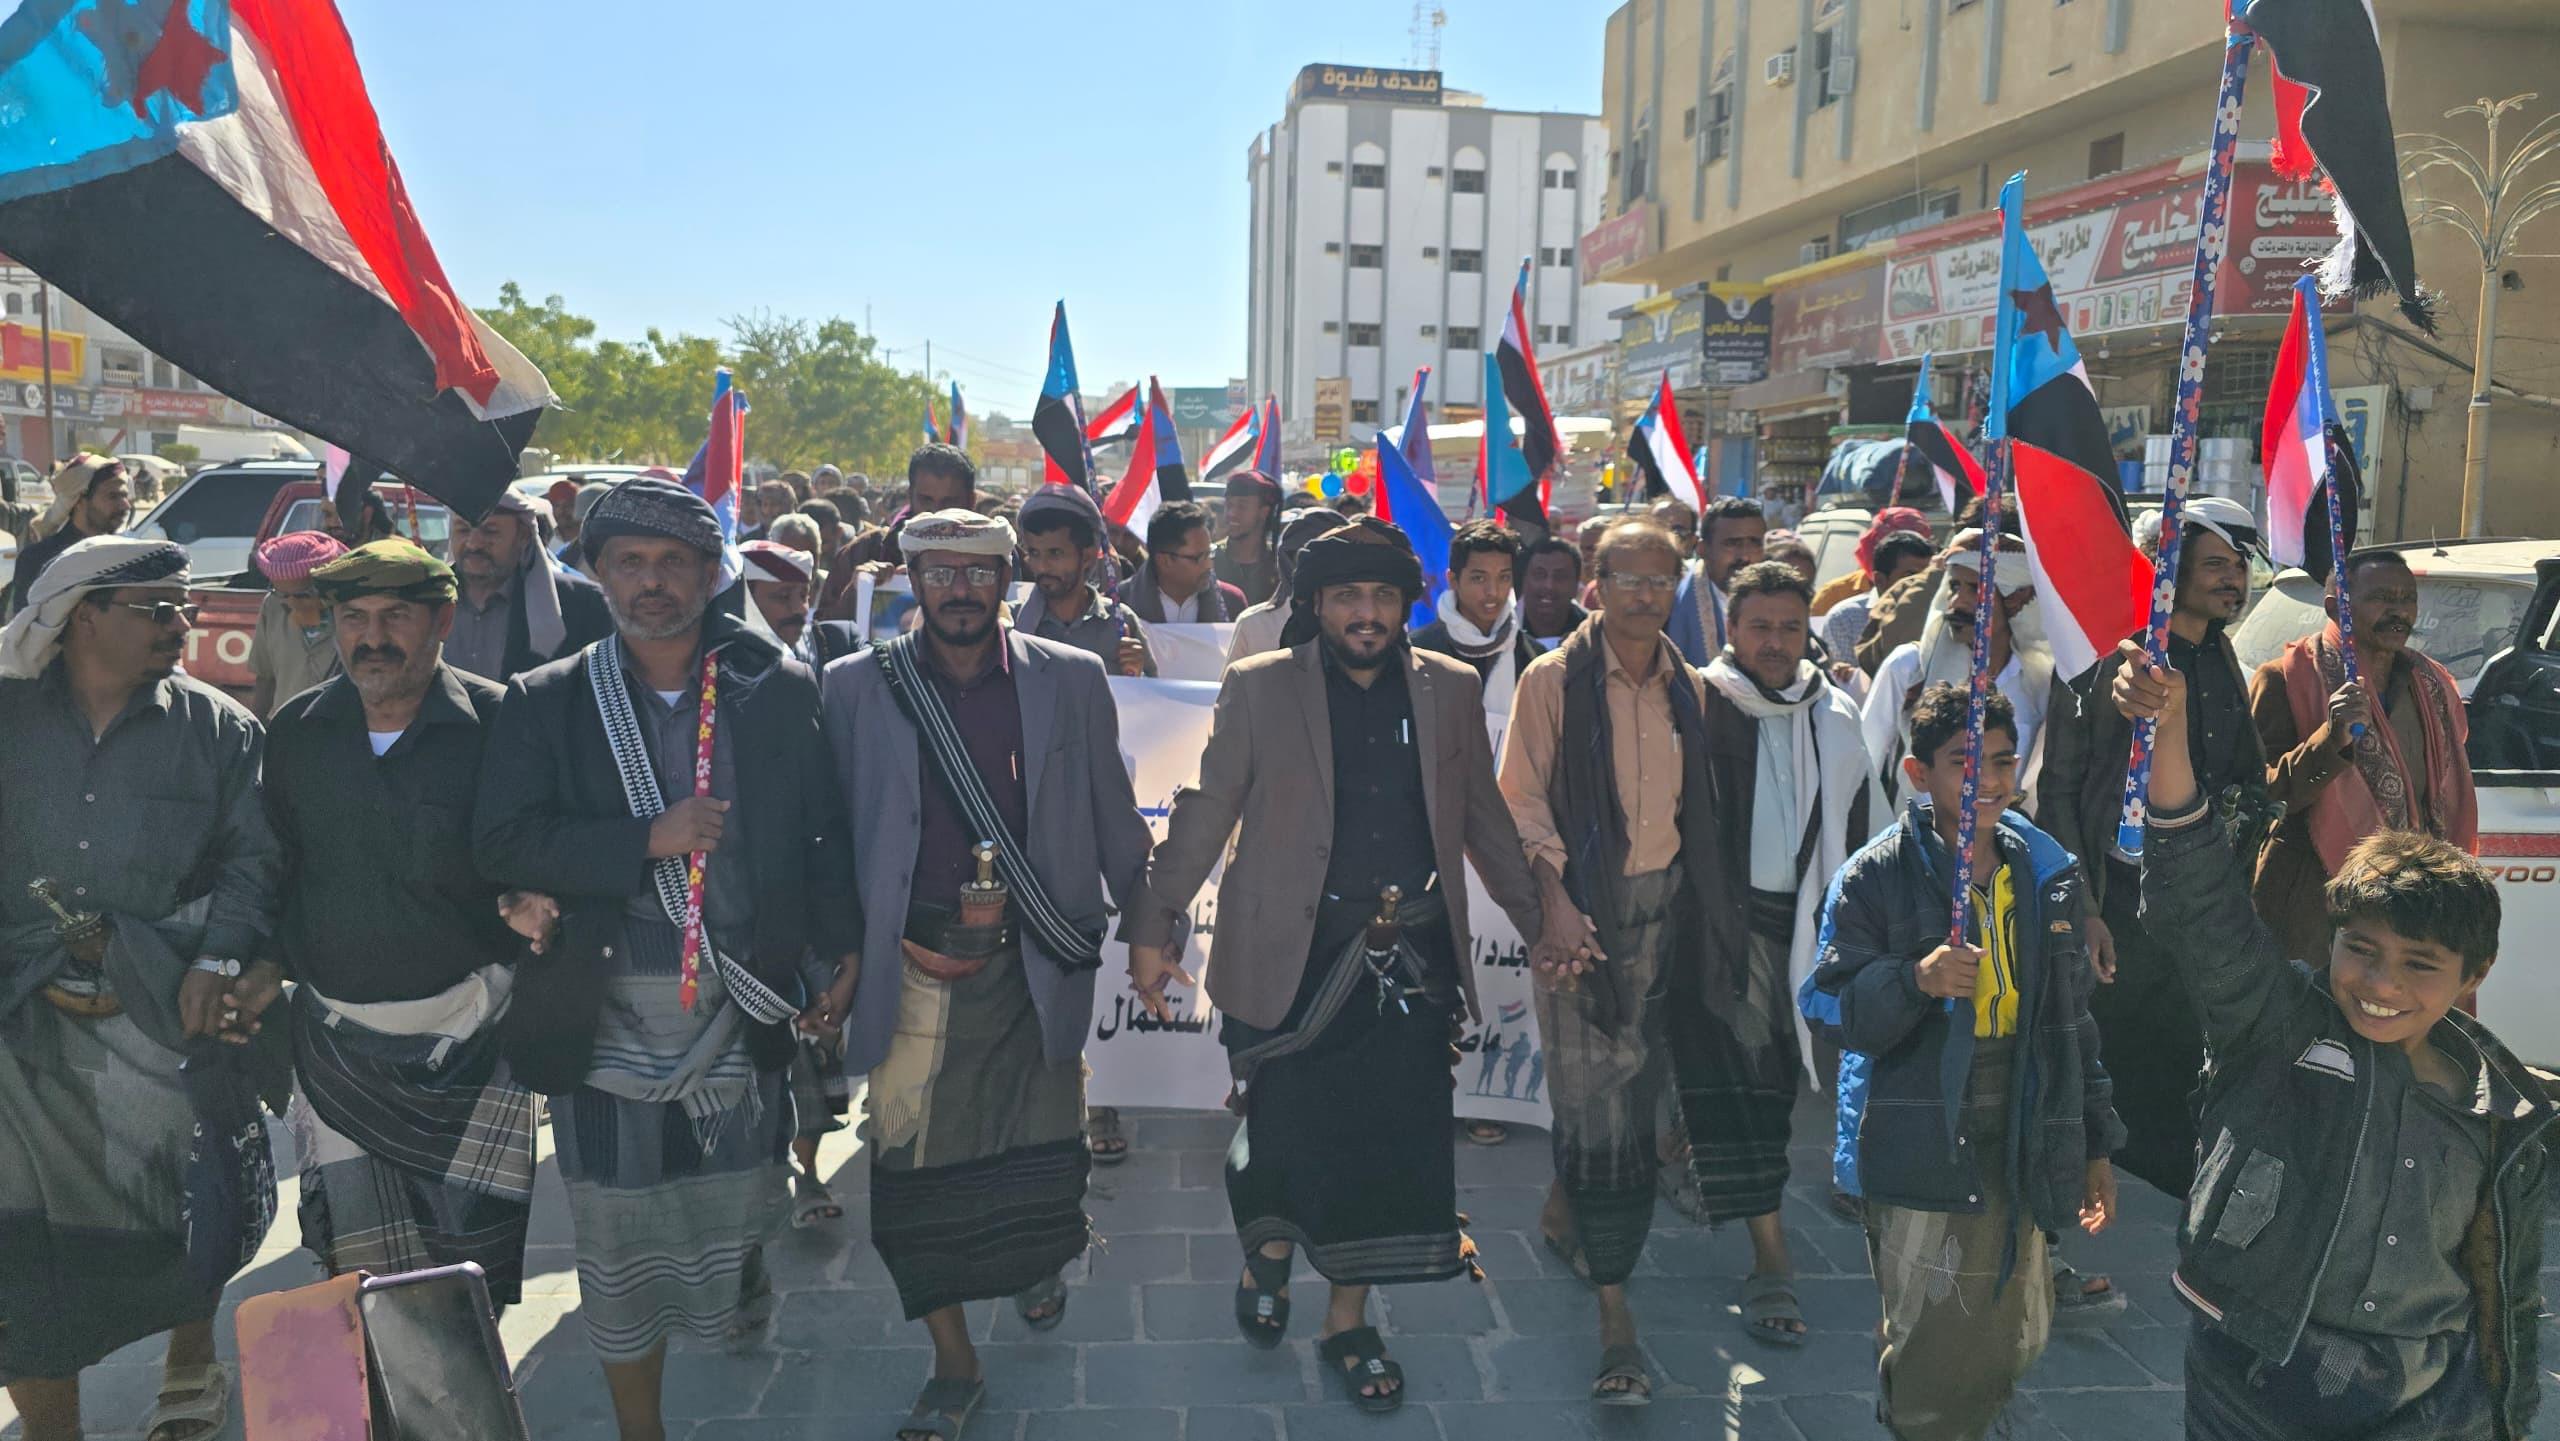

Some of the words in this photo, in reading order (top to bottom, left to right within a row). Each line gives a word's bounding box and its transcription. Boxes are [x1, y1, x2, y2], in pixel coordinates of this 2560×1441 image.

[1323, 66, 1378, 92] شبوة
[1382, 72, 1438, 92] فندق
[2255, 171, 2337, 228] خليج
[2121, 193, 2202, 270] لخليج
[2481, 866, 2556, 883] 700
